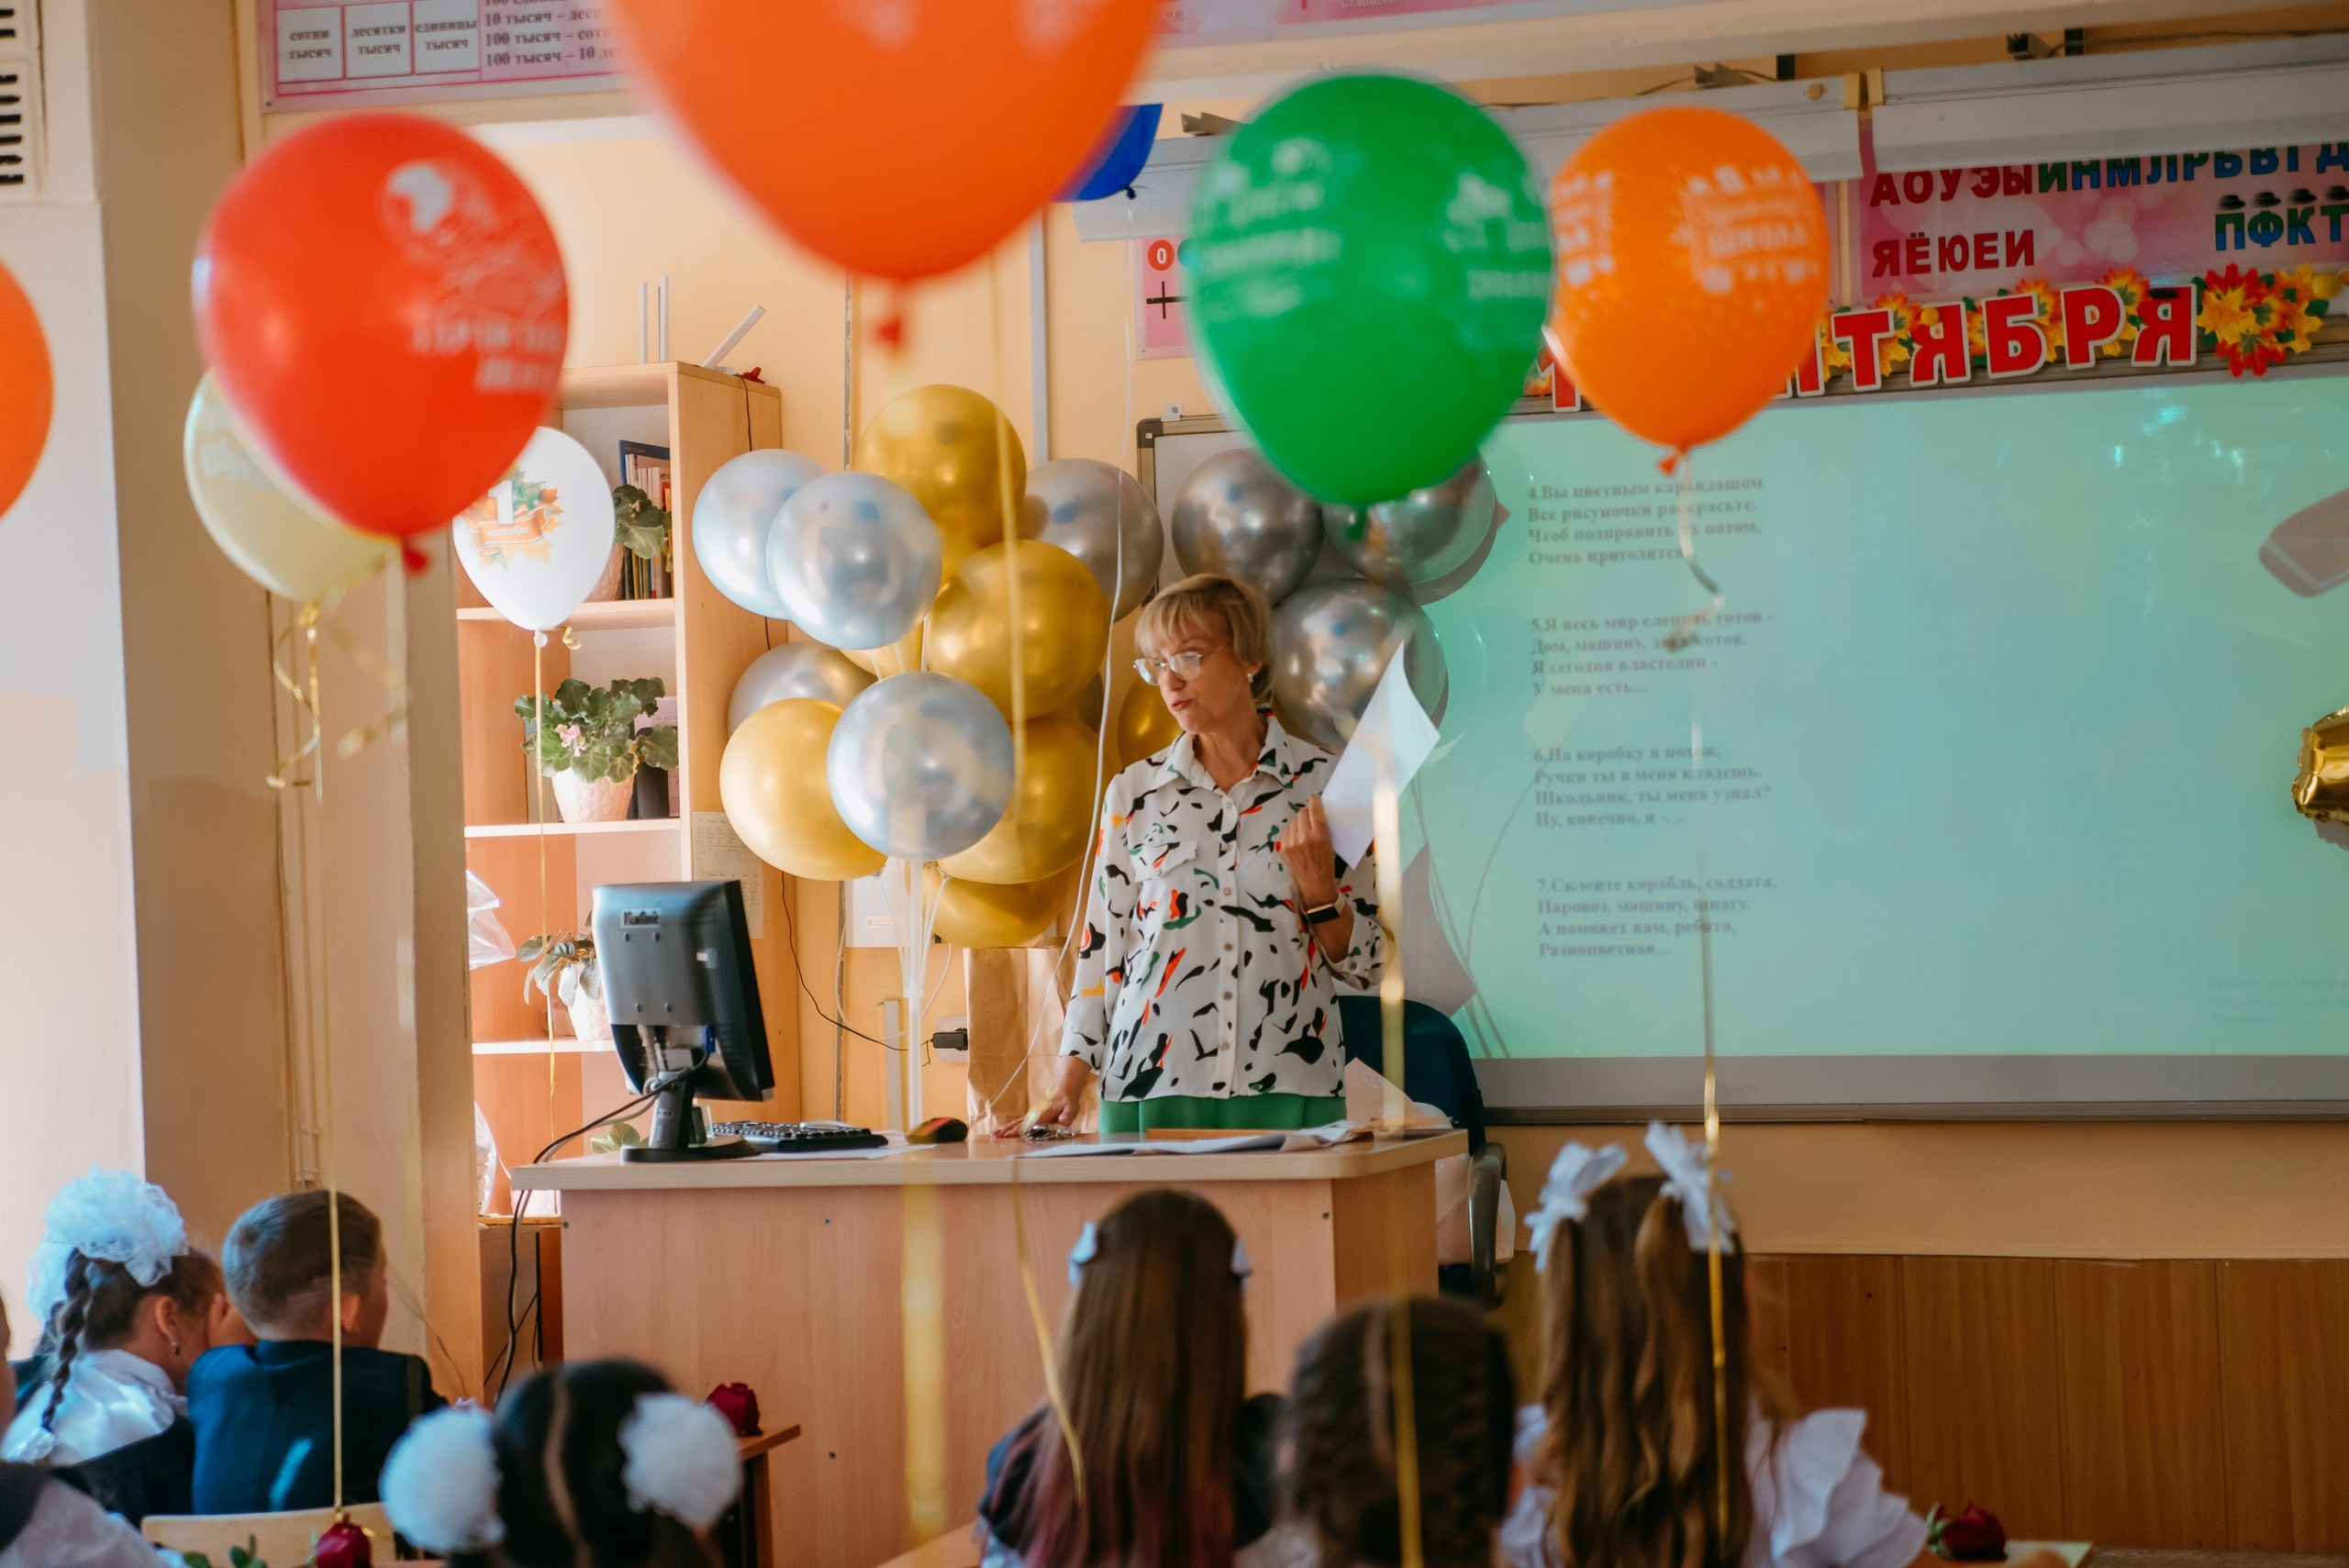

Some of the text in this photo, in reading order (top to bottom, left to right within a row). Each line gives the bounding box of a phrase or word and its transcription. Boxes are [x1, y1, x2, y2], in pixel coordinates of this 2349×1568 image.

[416, 20, 477, 33] единицы
[484, 13, 501, 27] 10
[507, 11, 552, 25] тысяч
[290, 30, 329, 41] сотни
[351, 25, 406, 39] десятки
[485, 32, 510, 47] 100
[515, 30, 562, 45] тысяч
[358, 43, 401, 56] тысяч
[425, 39, 469, 51] тысяч
[289, 48, 332, 60] тысяч
[486, 52, 510, 67] 100
[515, 50, 562, 64] тысяч
[579, 47, 596, 61] 10
[1871, 229, 2035, 279] ЯЁЮЕИ
[1574, 483, 1650, 498] цветным
[1655, 477, 1764, 495] карандашом
[487, 480, 514, 526] 1
[1528, 507, 1557, 522] Все
[1562, 504, 1652, 524] рисуночки
[1529, 528, 1569, 543] Чтоб
[1575, 525, 1675, 542] подправить
[1529, 550, 1583, 565] Очень
[1564, 618, 1598, 631] весь
[1605, 616, 1638, 633] мир
[1717, 612, 1762, 625] готов
[1531, 661, 1545, 674] Я
[1532, 683, 1547, 696] У
[1551, 684, 1592, 696] меня
[1576, 745, 1645, 763] коробку
[1651, 748, 1660, 759] я
[1535, 770, 1586, 788] Ручки
[1592, 771, 1615, 784] ты
[1620, 771, 1631, 783] в
[1635, 769, 1677, 782] меня
[1639, 789, 1660, 803] ты
[1665, 788, 1708, 802] меня
[1645, 812, 1655, 824] я
[1539, 921, 1552, 936] А
[1556, 922, 1627, 936] поможет
